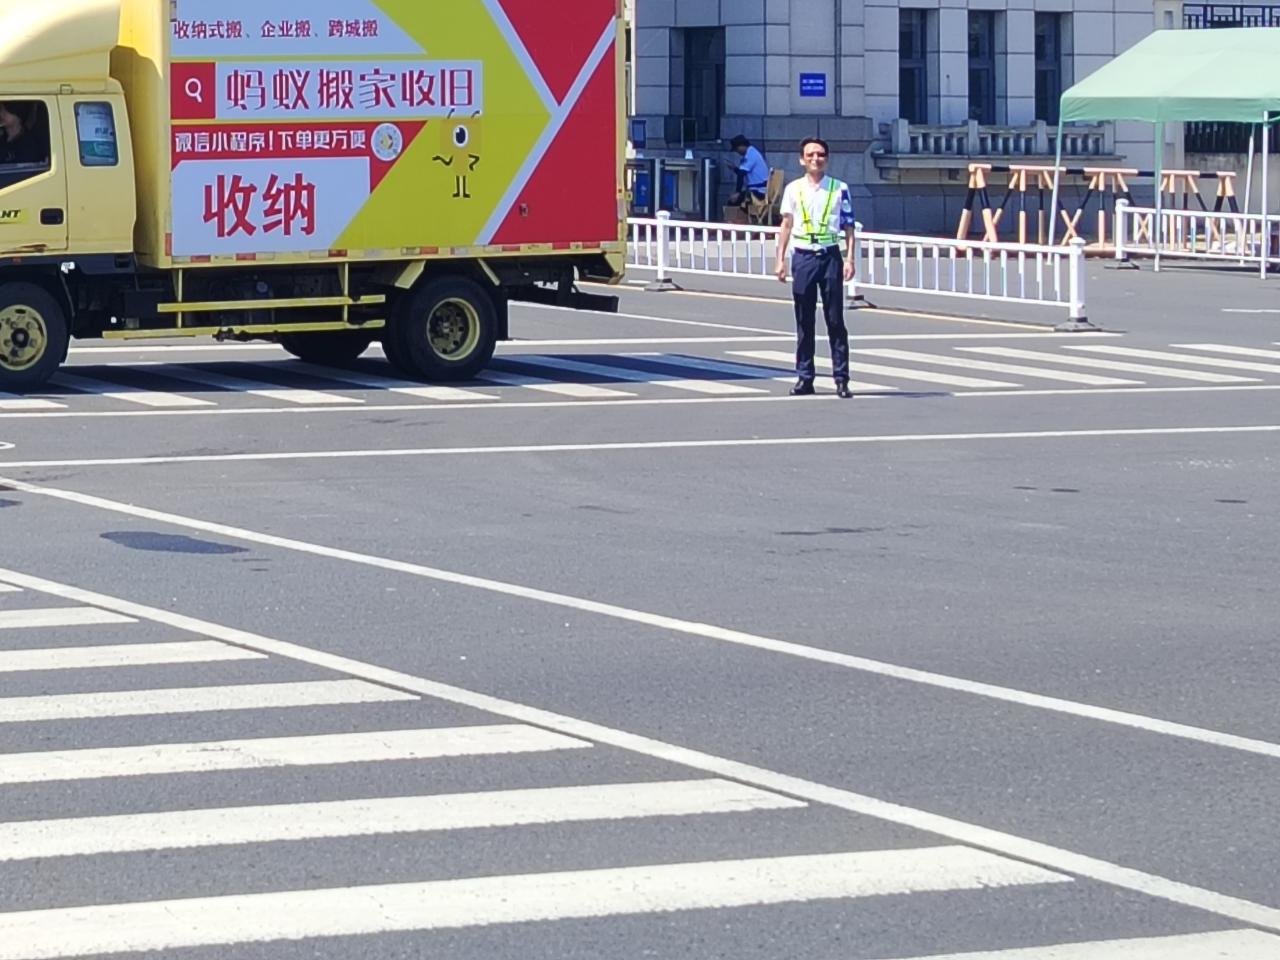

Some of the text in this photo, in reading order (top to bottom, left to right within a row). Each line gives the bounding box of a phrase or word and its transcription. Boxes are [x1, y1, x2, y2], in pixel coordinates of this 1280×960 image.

[225, 67, 473, 111] 蚂蚁搬家收旧
[202, 172, 317, 238] 收纳
